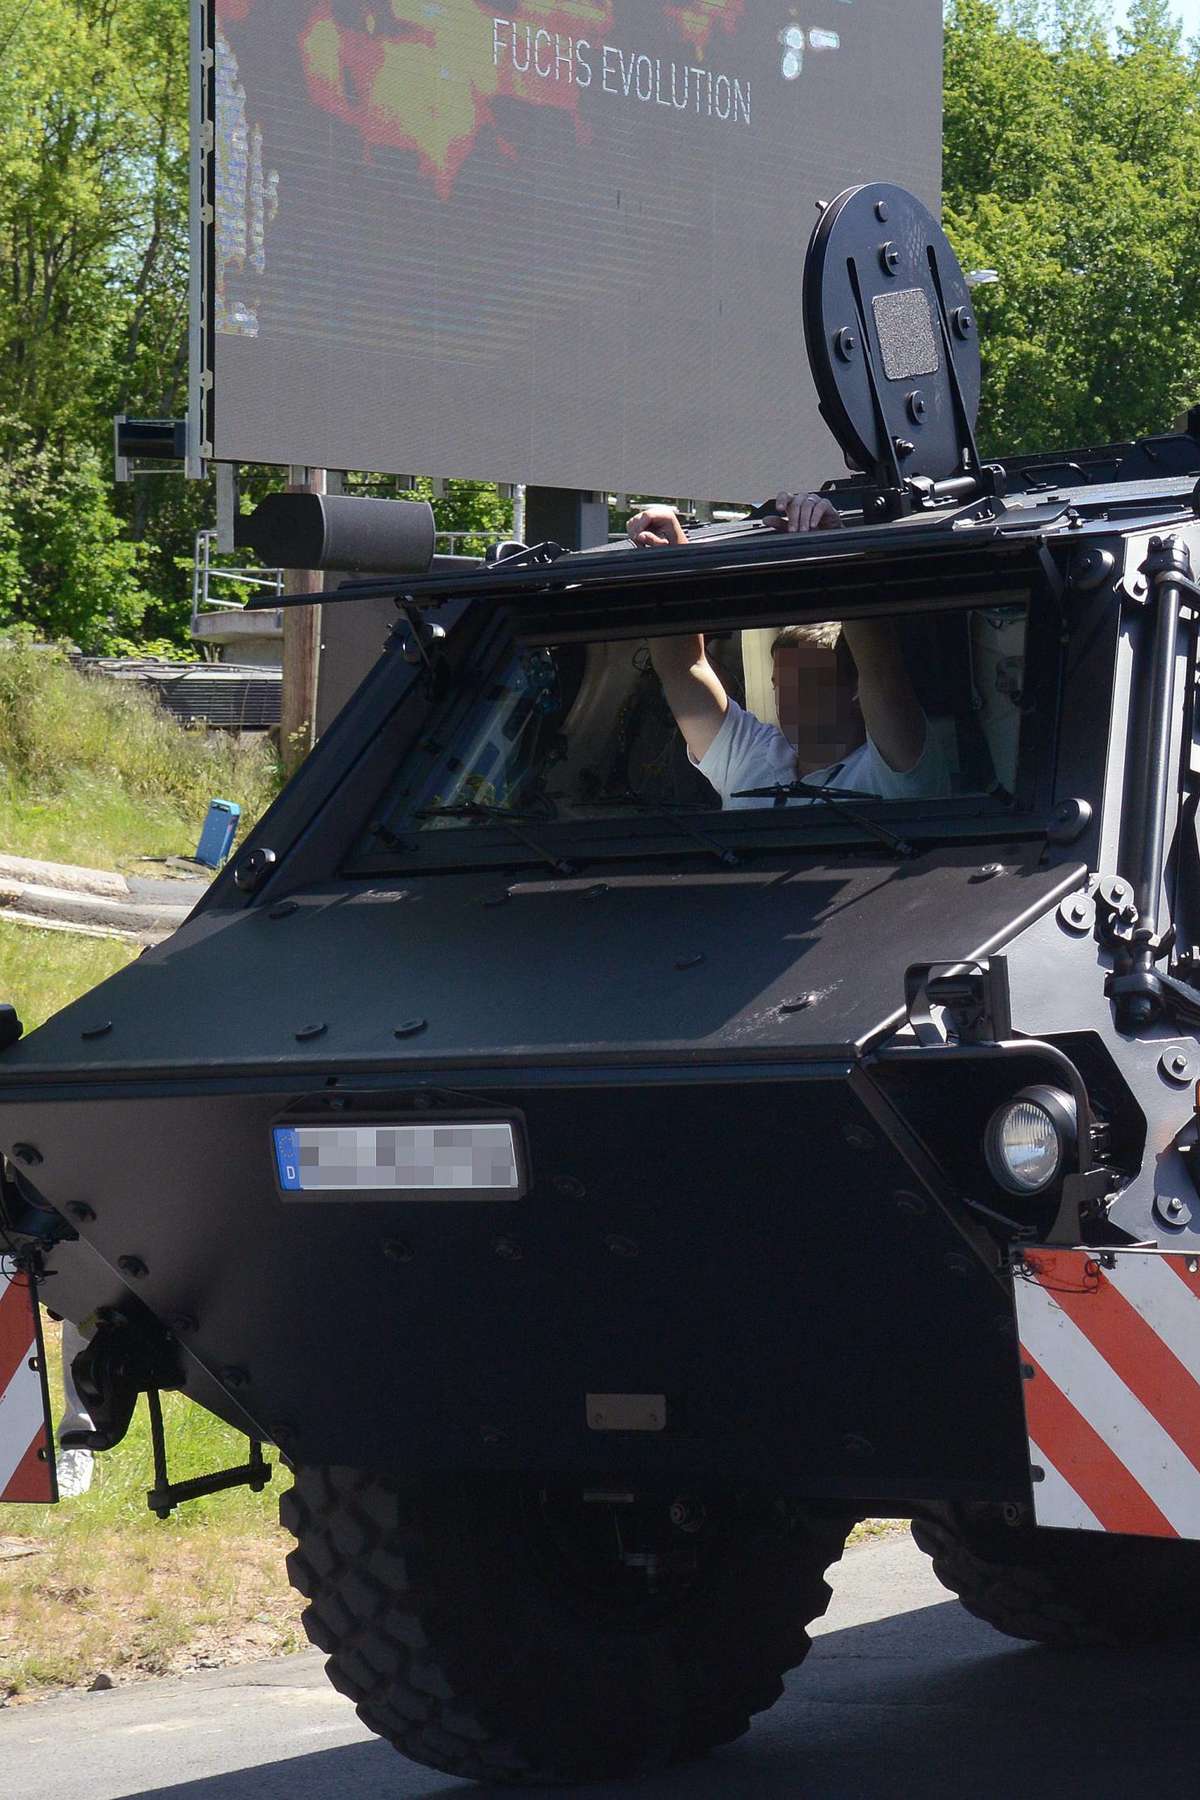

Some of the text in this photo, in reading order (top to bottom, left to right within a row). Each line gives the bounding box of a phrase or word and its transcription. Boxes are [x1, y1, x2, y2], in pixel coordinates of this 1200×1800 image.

[494, 18, 751, 125] FUCHS EVOLUTION
[286, 1166, 296, 1180] D
